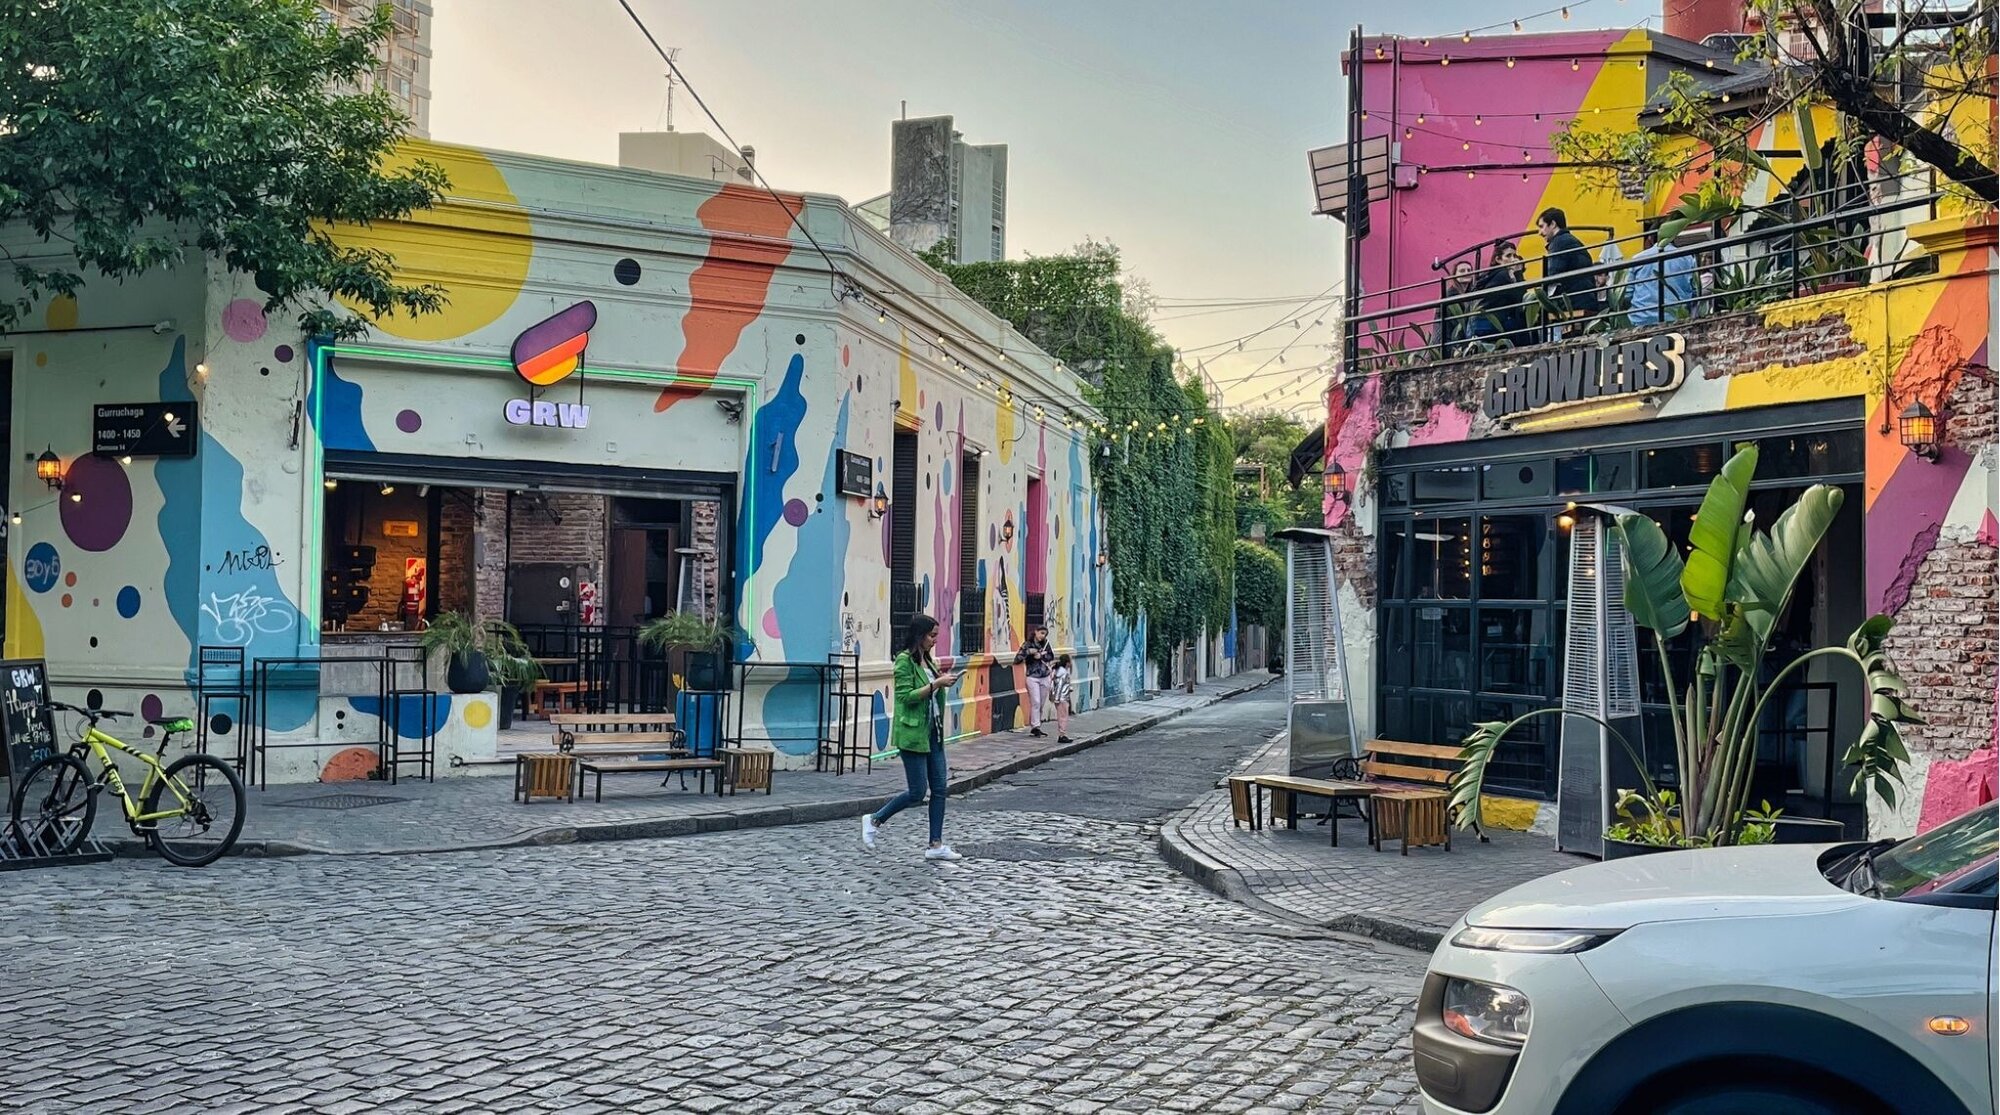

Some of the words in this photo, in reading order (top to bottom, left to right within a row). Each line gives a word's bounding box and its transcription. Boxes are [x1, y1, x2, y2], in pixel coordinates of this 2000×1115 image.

[1483, 335, 1670, 418] GROWLERS
[97, 407, 144, 418] Gurruchaga
[504, 398, 590, 428] GRW
[98, 430, 116, 439] 1400
[122, 429, 141, 439] 1450
[1483, 537, 1491, 549] 8
[11, 668, 35, 688] GRW
